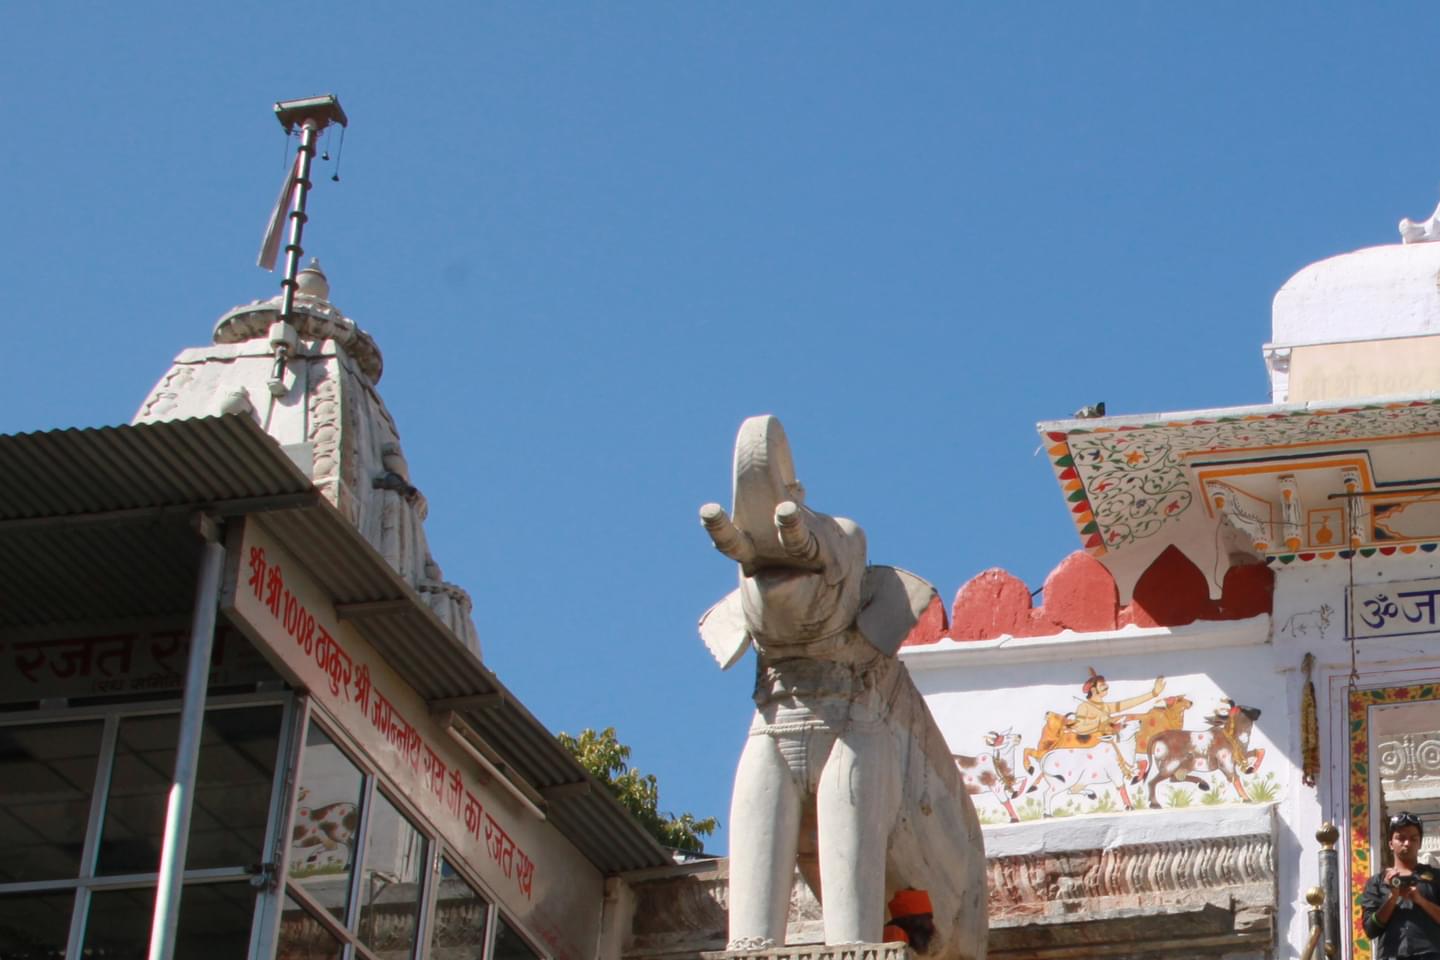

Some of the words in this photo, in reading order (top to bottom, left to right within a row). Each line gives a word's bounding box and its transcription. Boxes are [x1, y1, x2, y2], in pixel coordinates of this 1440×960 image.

[14, 633, 144, 684] रजत
[249, 546, 266, 601] श्री
[266, 565, 283, 619] श्री
[283, 589, 315, 656] 1008
[315, 624, 352, 701] ठाकुर
[354, 664, 371, 718] श्री
[448, 768, 464, 820] जी
[464, 789, 483, 841] का
[485, 811, 516, 879] रजत
[516, 848, 535, 901] रथ
